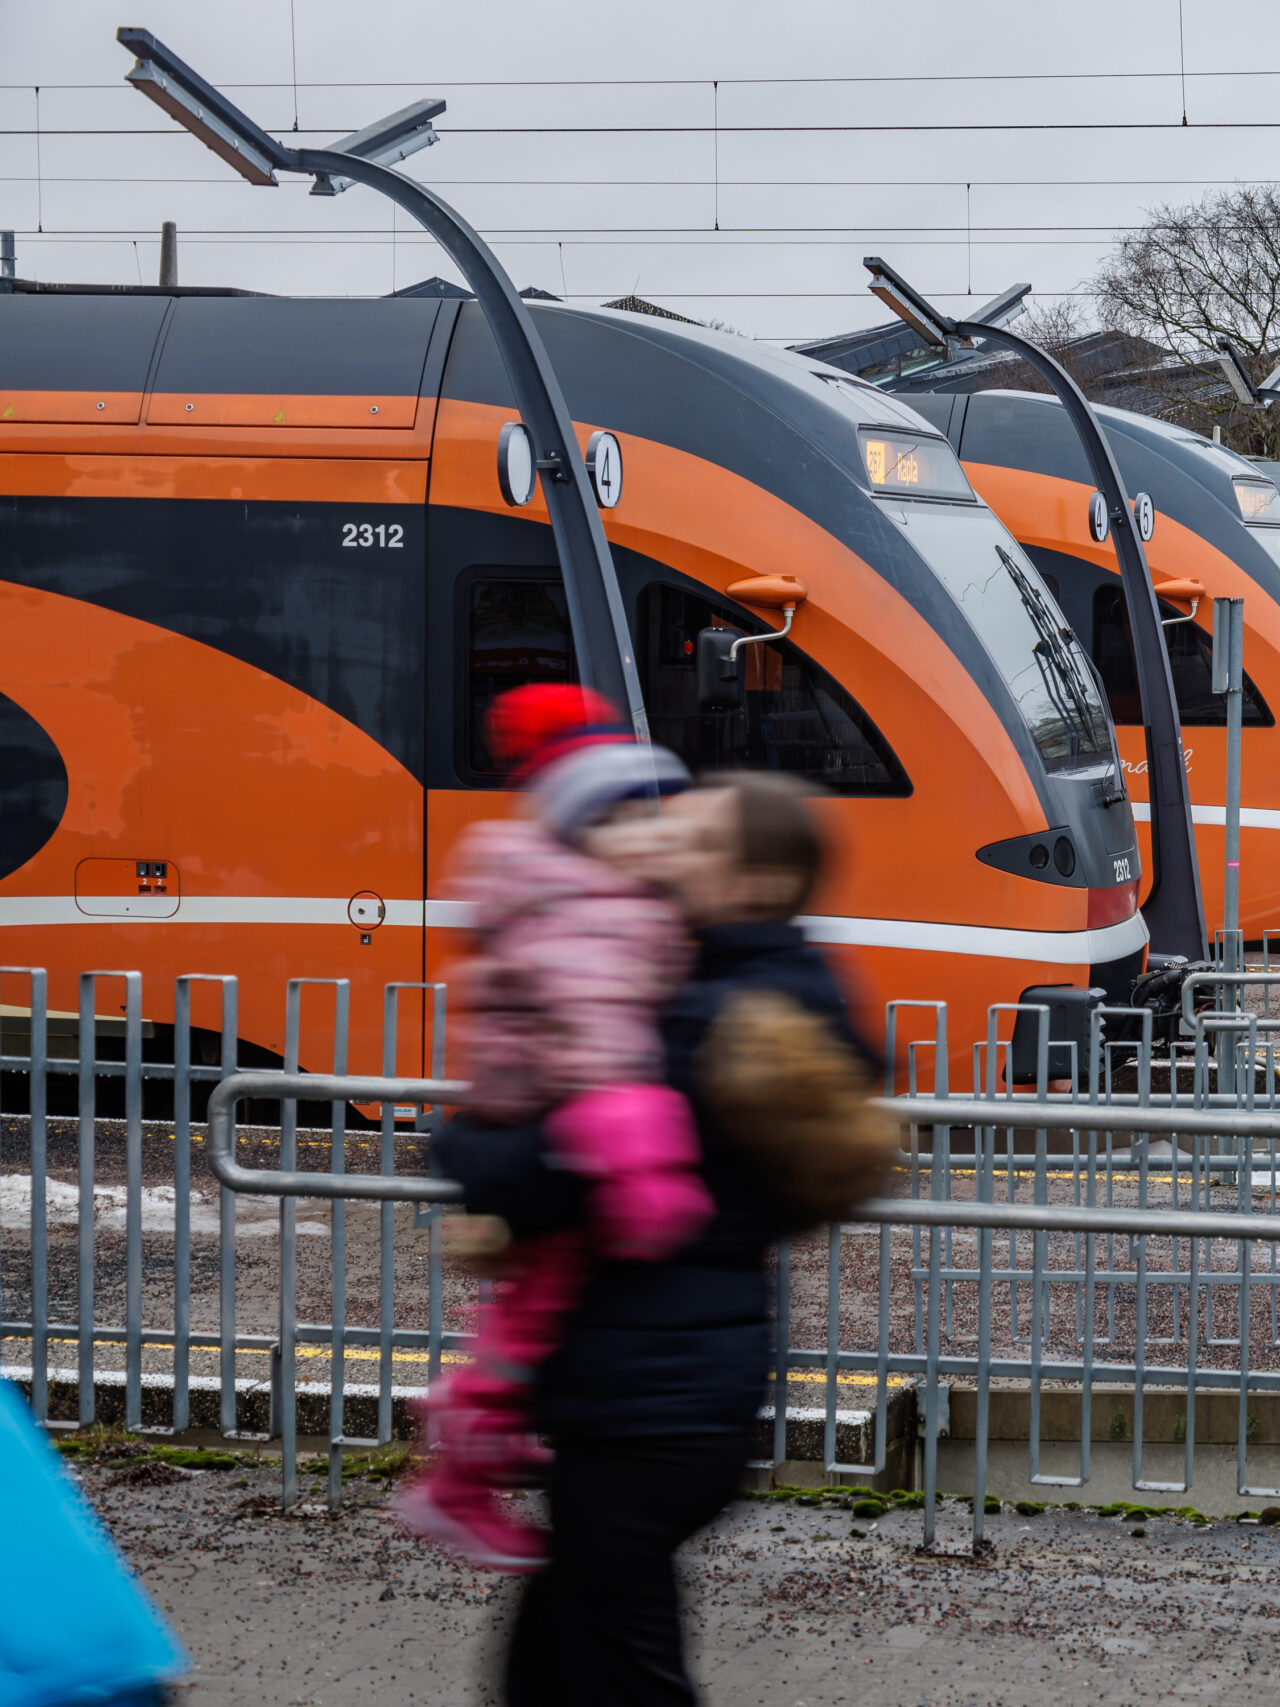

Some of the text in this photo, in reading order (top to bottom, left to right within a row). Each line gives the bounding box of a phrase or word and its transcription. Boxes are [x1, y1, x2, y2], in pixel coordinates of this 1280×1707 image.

[601, 446, 612, 499] 4
[897, 452, 918, 487] Rapla
[342, 523, 404, 548] 2312
[1113, 857, 1132, 883] 2312
